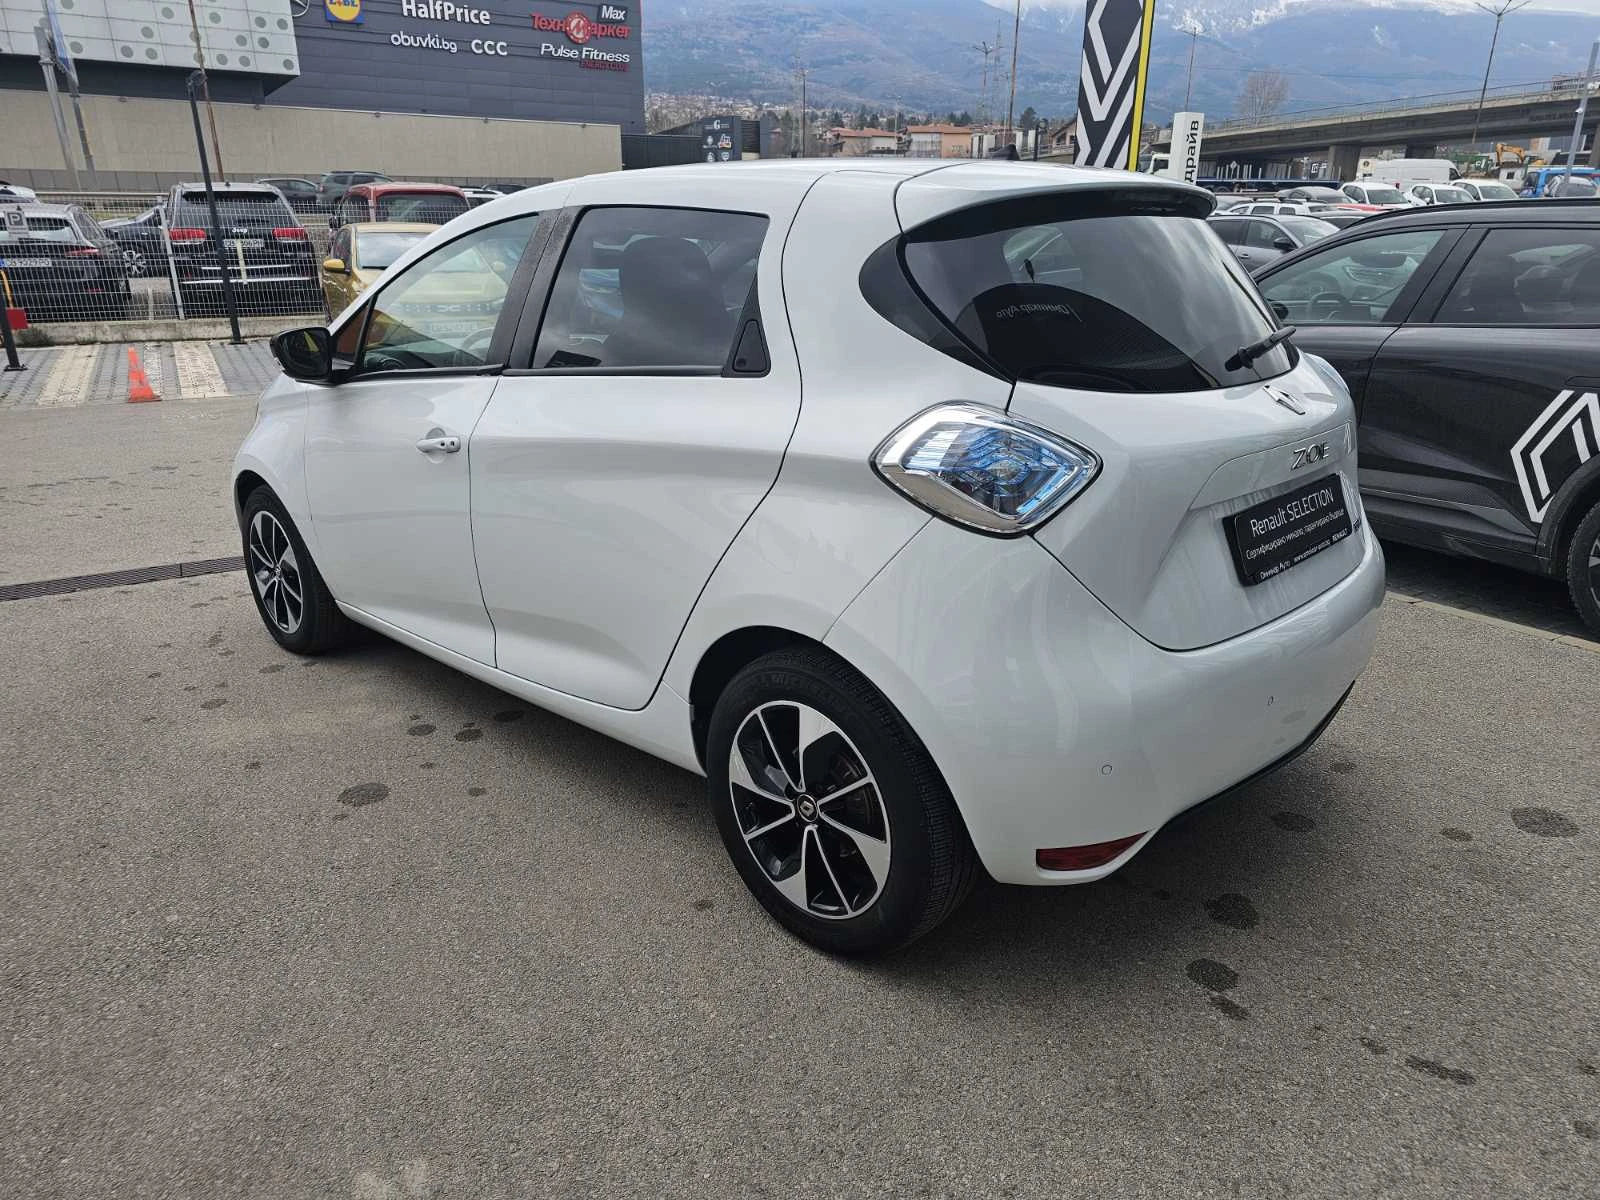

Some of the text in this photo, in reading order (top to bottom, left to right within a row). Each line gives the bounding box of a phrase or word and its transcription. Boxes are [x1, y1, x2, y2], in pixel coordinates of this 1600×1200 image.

[401, 0, 491, 25] HalfPrice
[601, 5, 626, 20] Max
[390, 31, 458, 54] obuvki.bg
[471, 40, 508, 56] CCC
[540, 43, 631, 63] Pulse Fitness
[1184, 119, 1199, 183] драйв
[8, 214, 20, 225] P
[1250, 488, 1334, 537] Renault SELECTION
